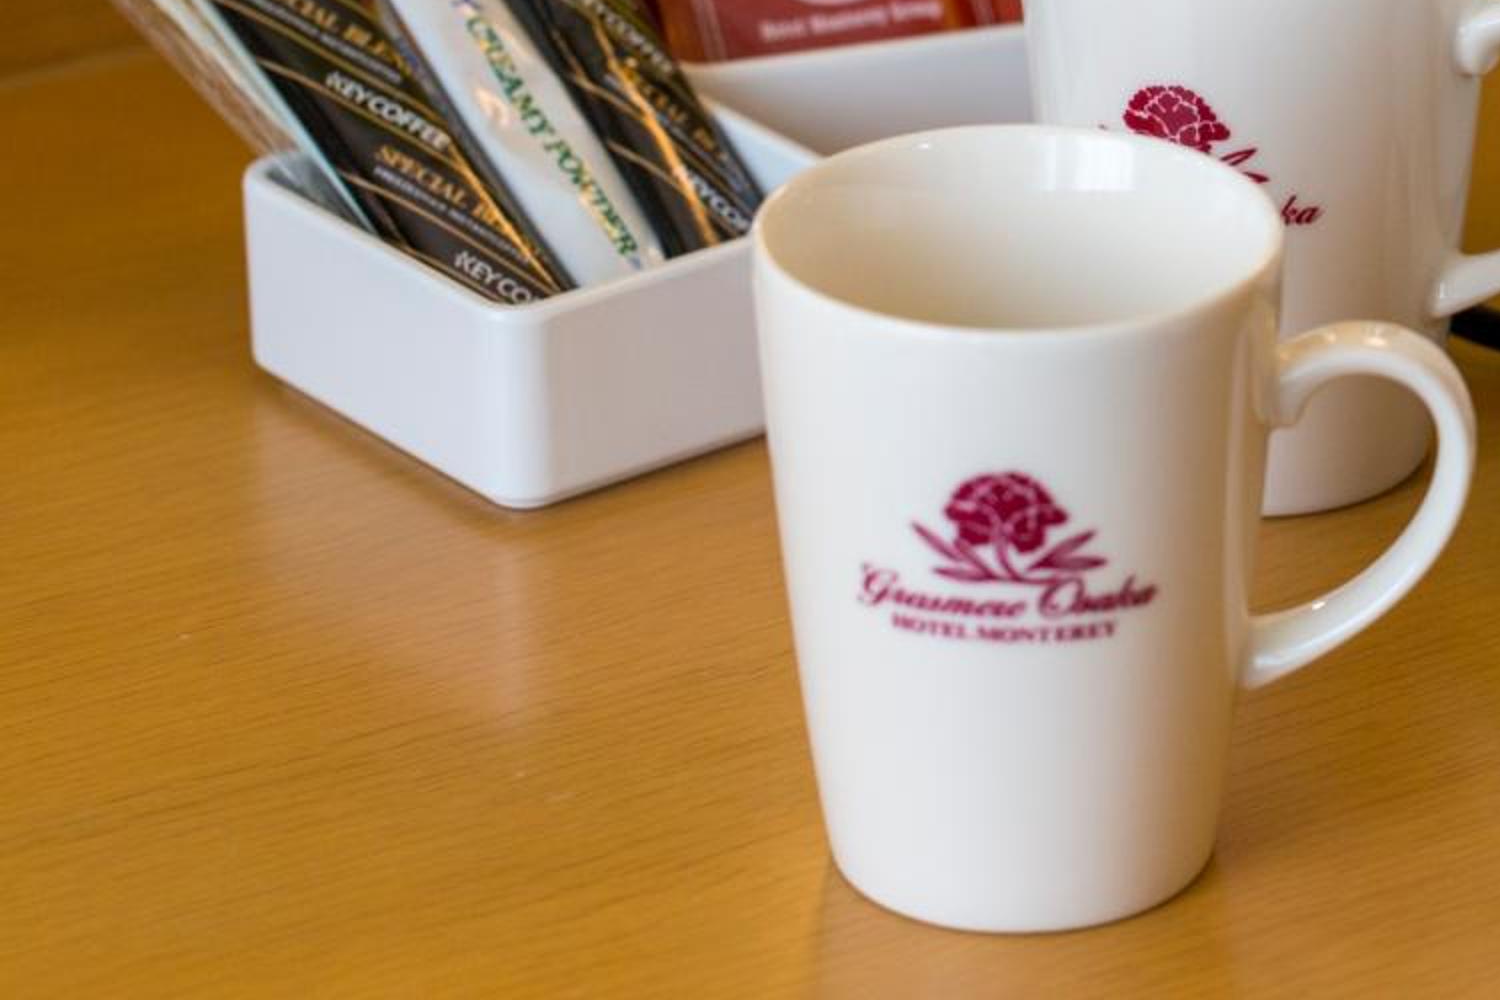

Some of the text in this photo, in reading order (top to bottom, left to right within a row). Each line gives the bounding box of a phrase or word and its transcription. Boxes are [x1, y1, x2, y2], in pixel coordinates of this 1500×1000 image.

[465, 14, 555, 137] CREAMY
[544, 137, 638, 256] POWDER
[1038, 575, 1158, 619] Osaka
[891, 613, 1118, 643] HOTEL MONTEREY
